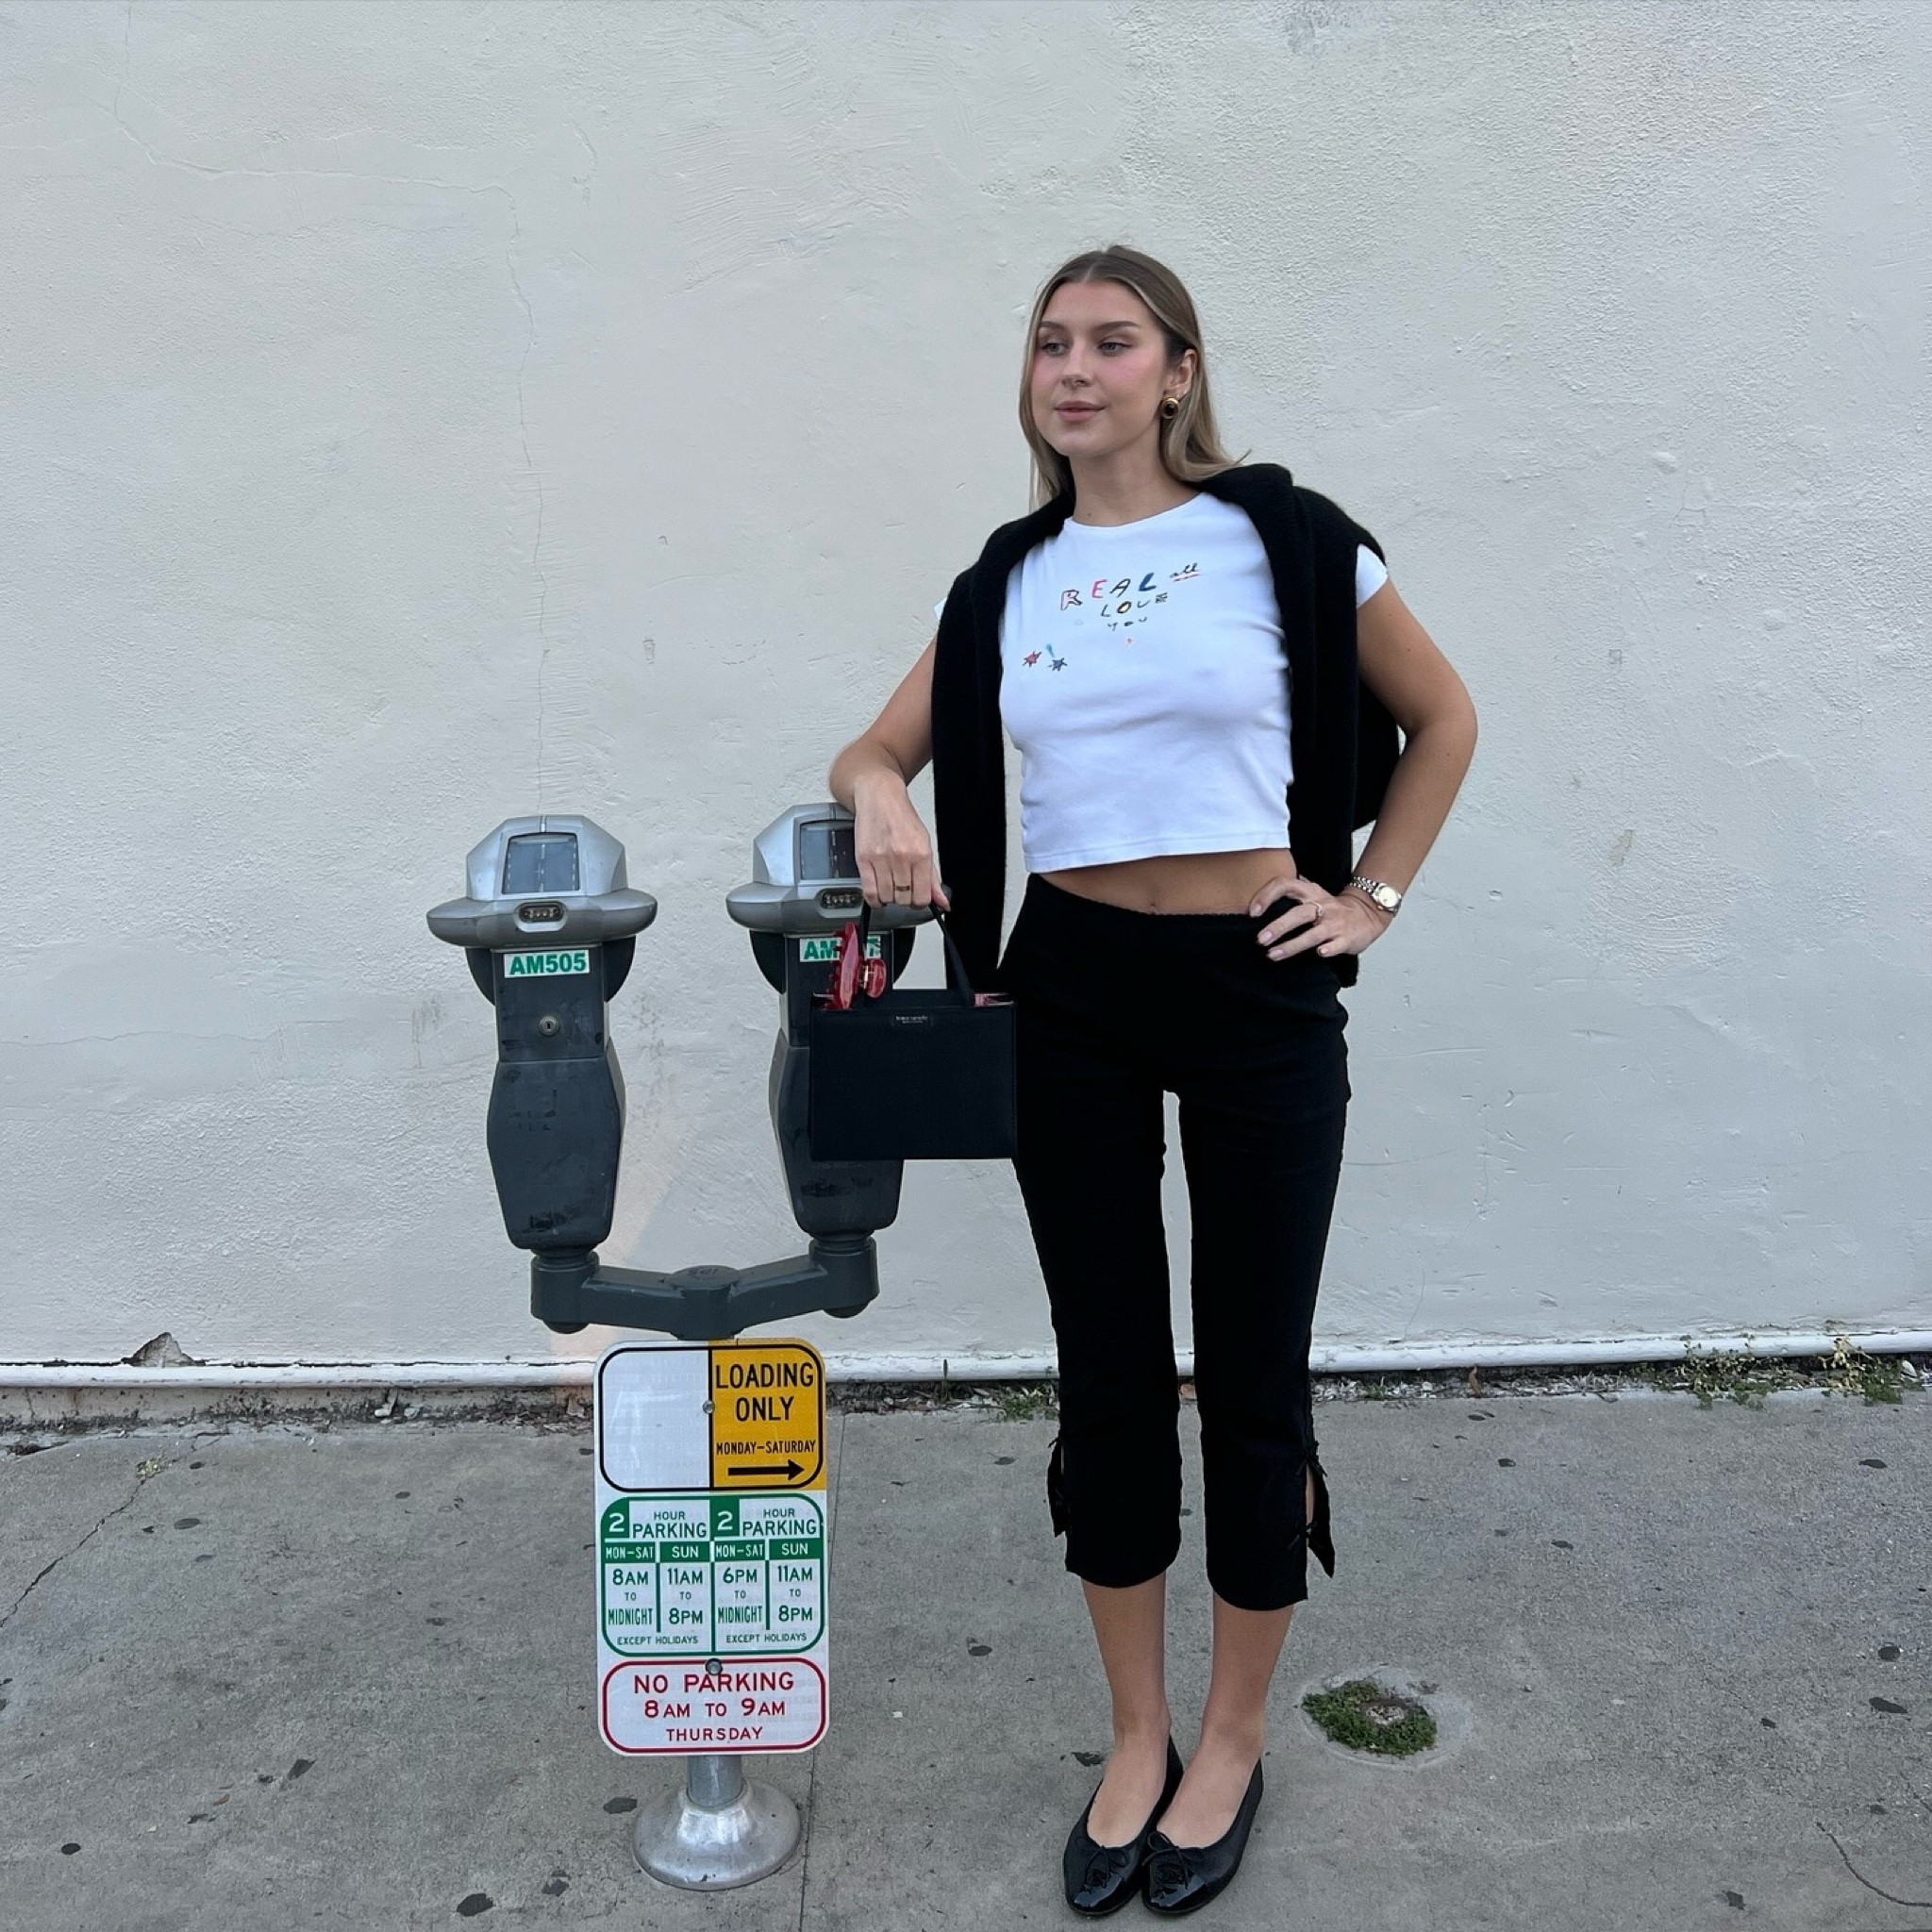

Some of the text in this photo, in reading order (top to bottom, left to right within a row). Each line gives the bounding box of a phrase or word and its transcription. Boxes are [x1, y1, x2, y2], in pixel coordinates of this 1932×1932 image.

[1060, 573, 1157, 610] REAL
[509, 953, 586, 974] AM505
[716, 1363, 813, 1389] LOADING
[736, 1396, 793, 1422] ONLY
[654, 1511, 686, 1521] HOUR
[717, 1511, 733, 1530] 2
[763, 1508, 795, 1518] HOUR
[608, 1512, 625, 1533] 2
[633, 1522, 707, 1539] PARKING
[742, 1519, 816, 1536] PARKING
[606, 1547, 654, 1558] MON-SAT
[672, 1546, 699, 1557] SUN
[715, 1544, 764, 1557] MON-SAT
[781, 1543, 808, 1555] SUN
[613, 1569, 649, 1586] 8AM
[667, 1568, 703, 1586] 11AM
[723, 1567, 757, 1584] 6PM
[777, 1566, 812, 1582] 11AM
[625, 1592, 636, 1601] TO
[679, 1591, 691, 1600] TO
[734, 1591, 746, 1599] TO
[790, 1589, 801, 1597] TO
[608, 1608, 653, 1625] MIDNIGHT
[669, 1608, 703, 1624] 8PM
[718, 1606, 762, 1624] MIDNIGHT
[778, 1606, 812, 1622] 8PM
[617, 1636, 698, 1645] EXCEPT HOLIDAYS
[726, 1633, 807, 1643] EXCEPT HOLIDAYS
[634, 1672, 793, 1693] NO PARKING
[644, 1698, 785, 1718] 8AM TO 9AM
[666, 1726, 763, 1741] THURSDAY
